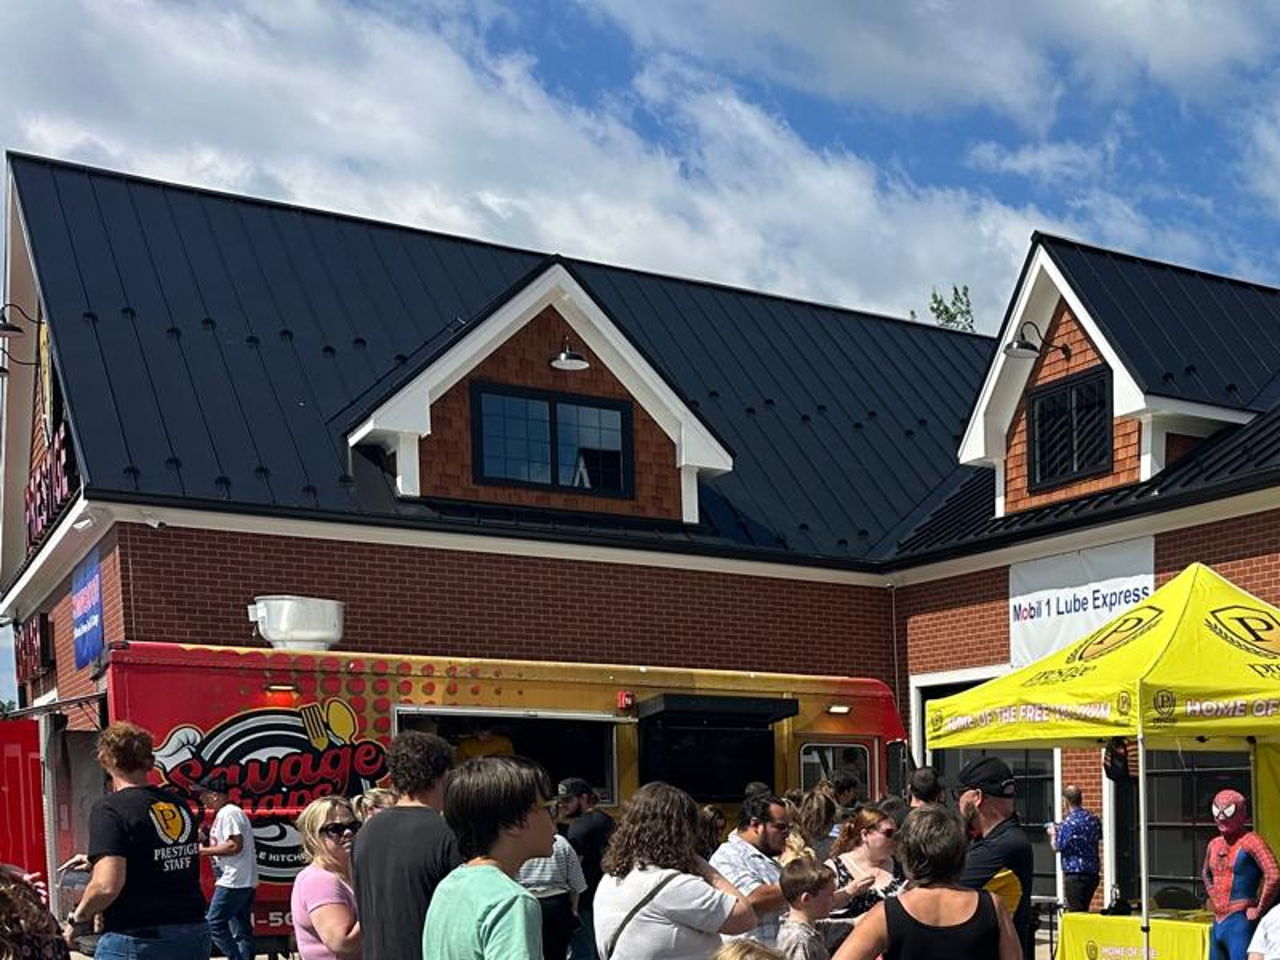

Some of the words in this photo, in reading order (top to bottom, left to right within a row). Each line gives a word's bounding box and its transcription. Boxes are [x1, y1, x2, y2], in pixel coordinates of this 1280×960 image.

[1013, 601, 1042, 621] Mobil
[1045, 598, 1051, 617] 1
[1056, 593, 1089, 616] Lube
[1092, 585, 1150, 612] Express
[996, 705, 1017, 723] THE
[1019, 703, 1050, 721] FREE
[1185, 700, 1247, 716] HOME
[1252, 701, 1280, 716] OF
[163, 857, 192, 872] STAFF
